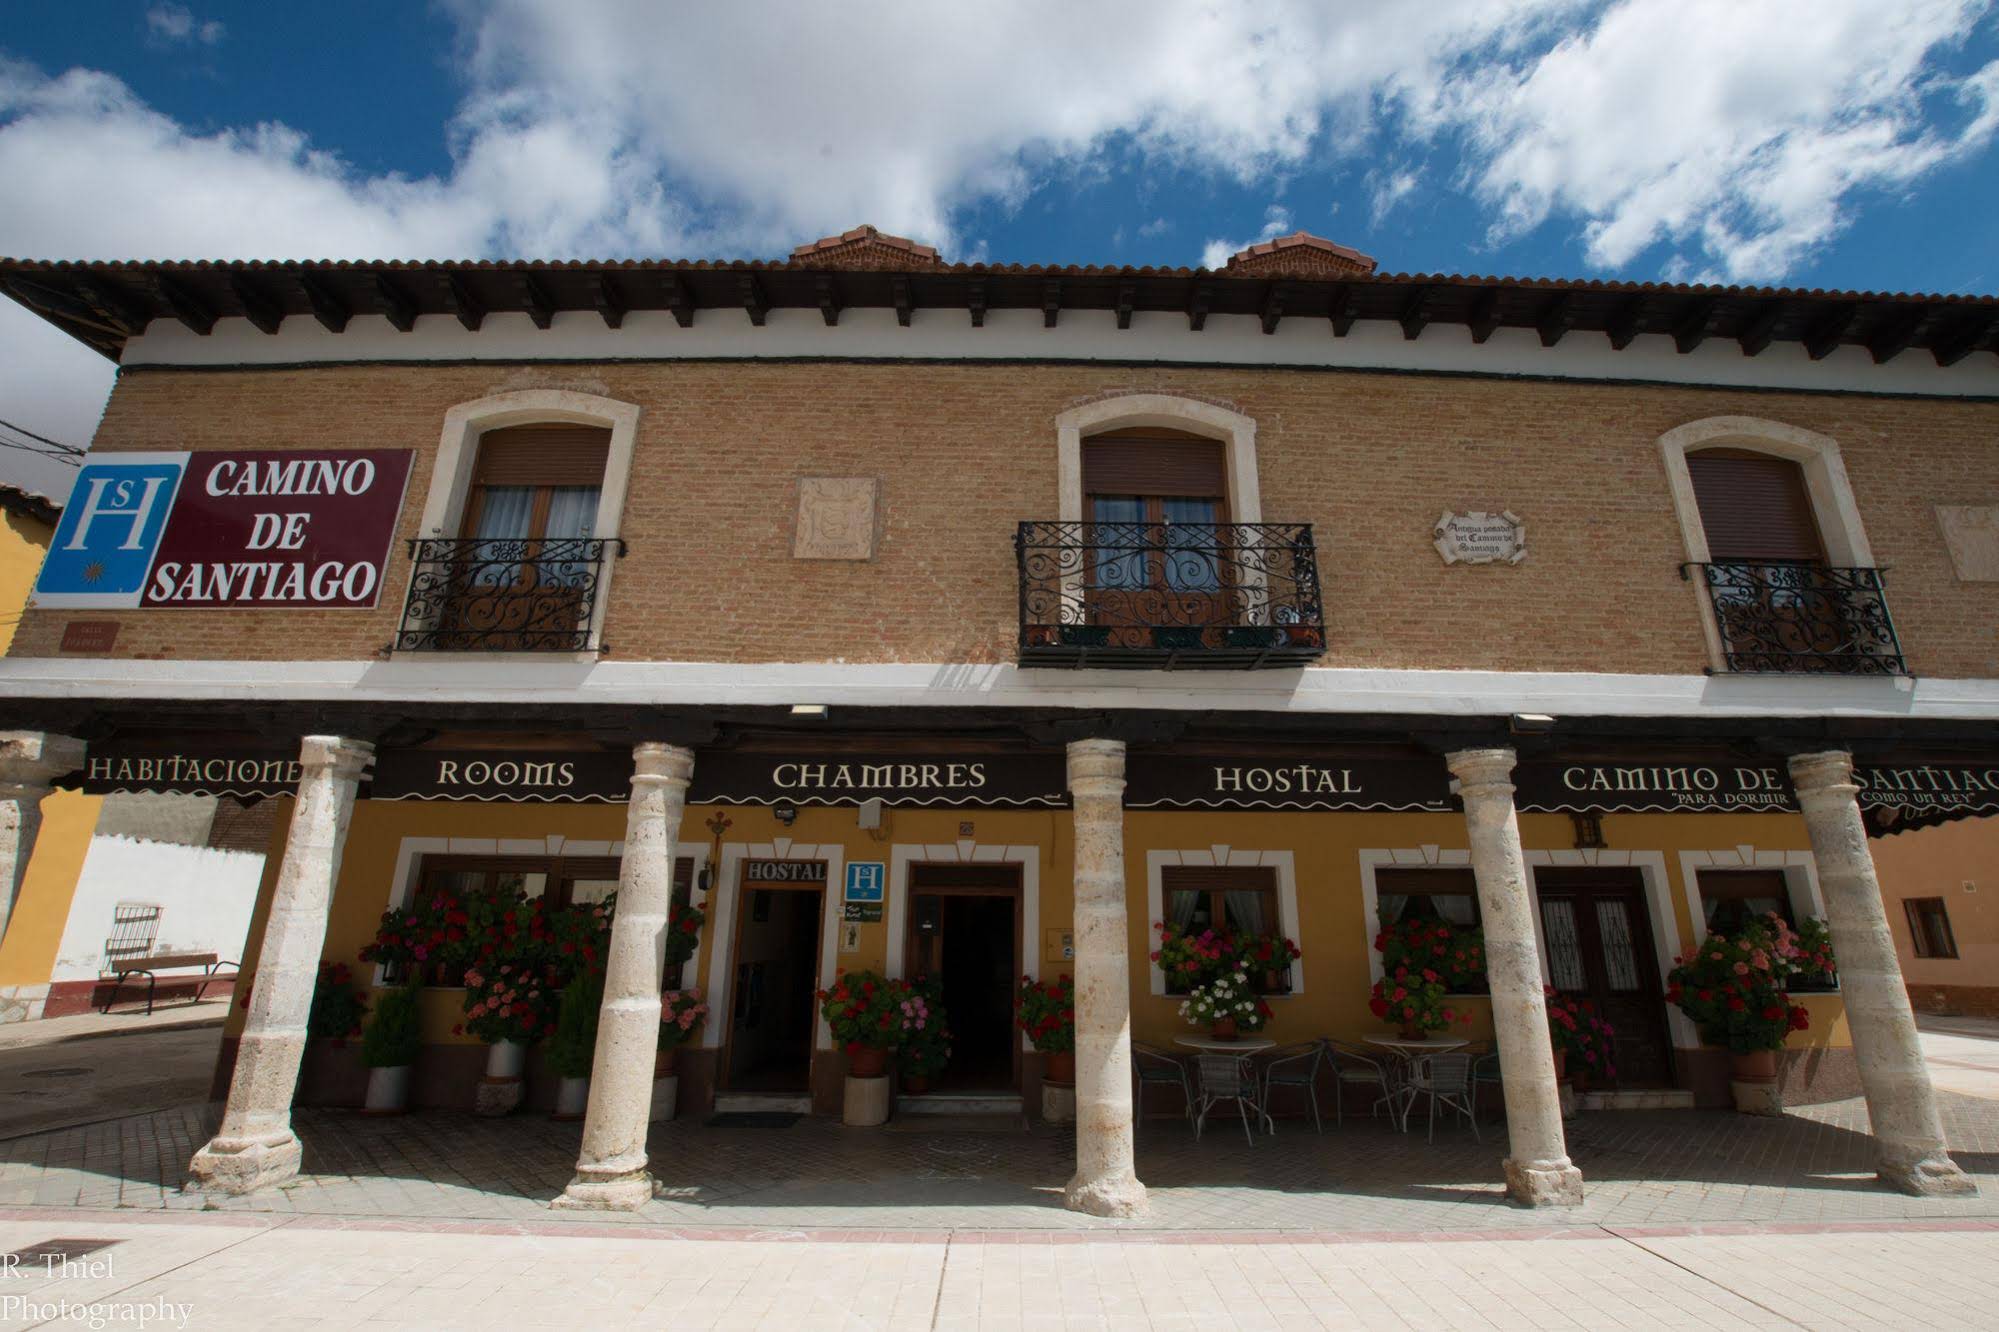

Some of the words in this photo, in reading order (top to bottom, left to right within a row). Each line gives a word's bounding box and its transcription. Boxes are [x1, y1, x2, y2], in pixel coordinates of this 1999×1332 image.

[205, 458, 375, 496] CAMINO
[245, 513, 311, 550] DE
[1468, 533, 1502, 542] Camino
[1458, 543, 1500, 553] Santiago
[148, 561, 377, 601] SANTIAGO
[437, 760, 575, 787] ROOMS
[772, 763, 986, 788] CHAMBRES
[1213, 764, 1362, 793] HOSTAL
[1563, 766, 1719, 792] CAMINO
[1733, 767, 1783, 791] DE
[1724, 792, 1790, 805] DORMIR
[1861, 791, 1909, 803] COMO
[1912, 792, 1937, 804] UN
[748, 862, 825, 881] HOSTAL
